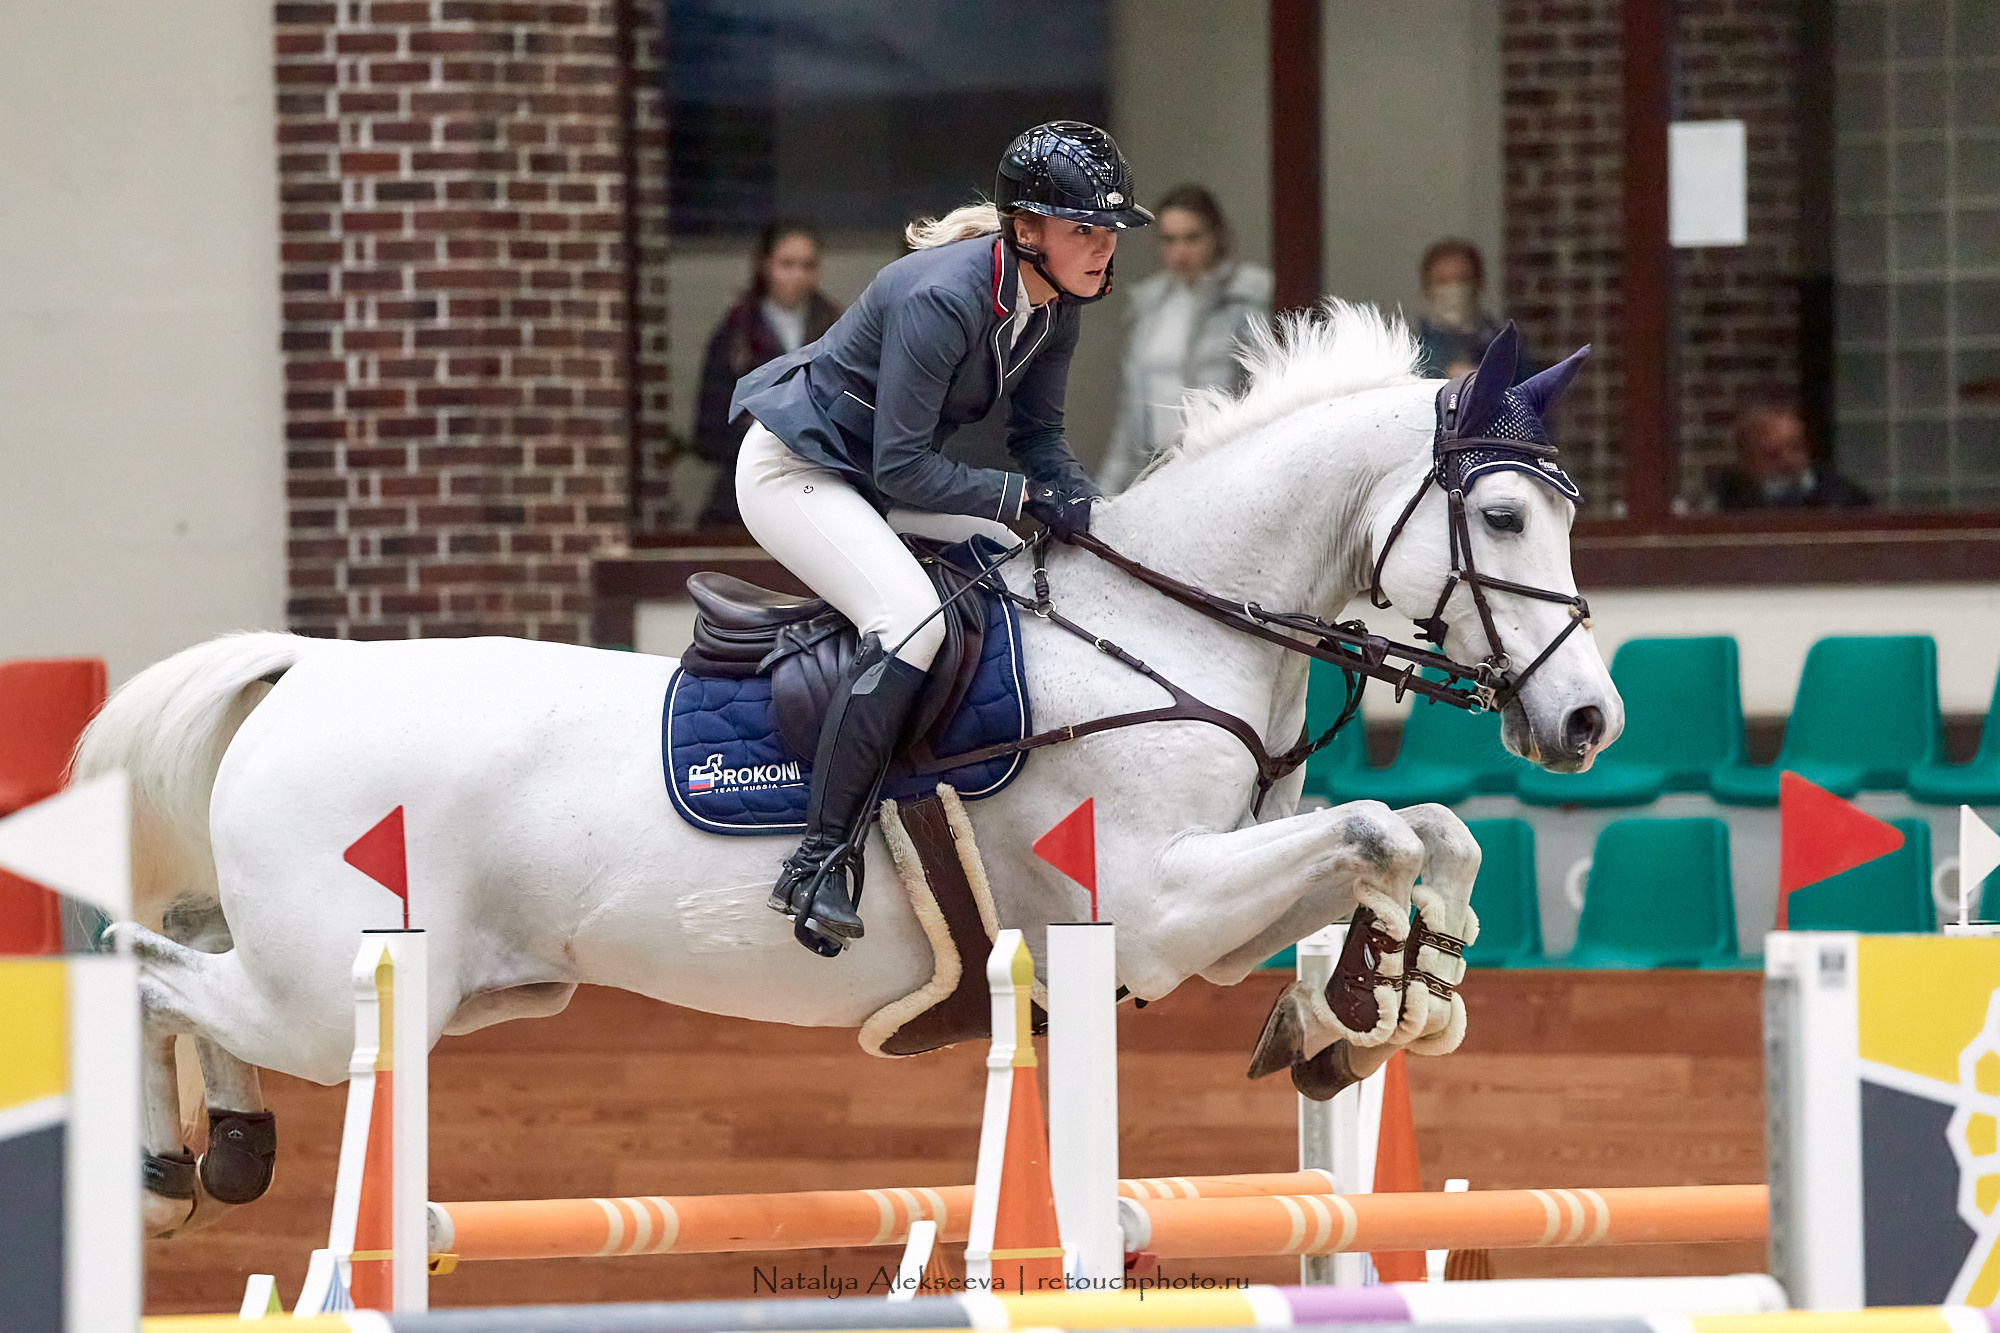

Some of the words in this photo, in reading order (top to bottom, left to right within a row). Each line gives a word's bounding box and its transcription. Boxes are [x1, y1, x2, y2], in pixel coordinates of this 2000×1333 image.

[709, 760, 801, 788] PROKONI
[714, 786, 740, 794] TEAM
[742, 783, 778, 792] RUSSIA
